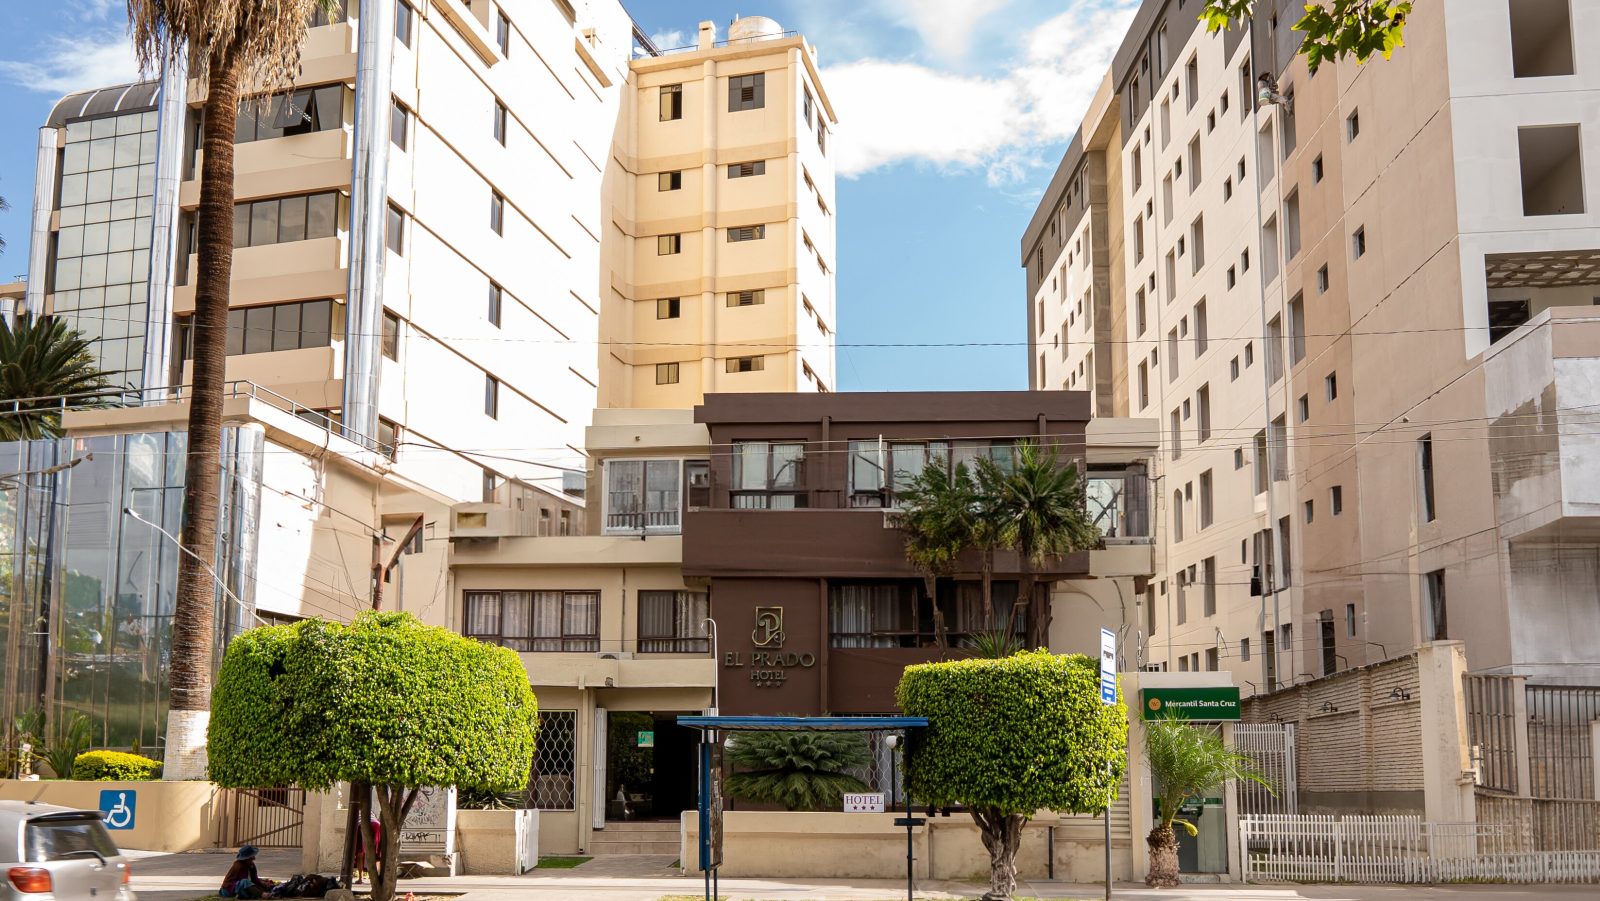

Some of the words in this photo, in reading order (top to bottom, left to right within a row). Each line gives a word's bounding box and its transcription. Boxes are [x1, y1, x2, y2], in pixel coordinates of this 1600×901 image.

[724, 651, 744, 666] EL
[751, 651, 816, 667] PRADO
[750, 670, 786, 680] HOTEL
[1165, 700, 1198, 708] Mercantil
[845, 795, 883, 805] HOTEL
